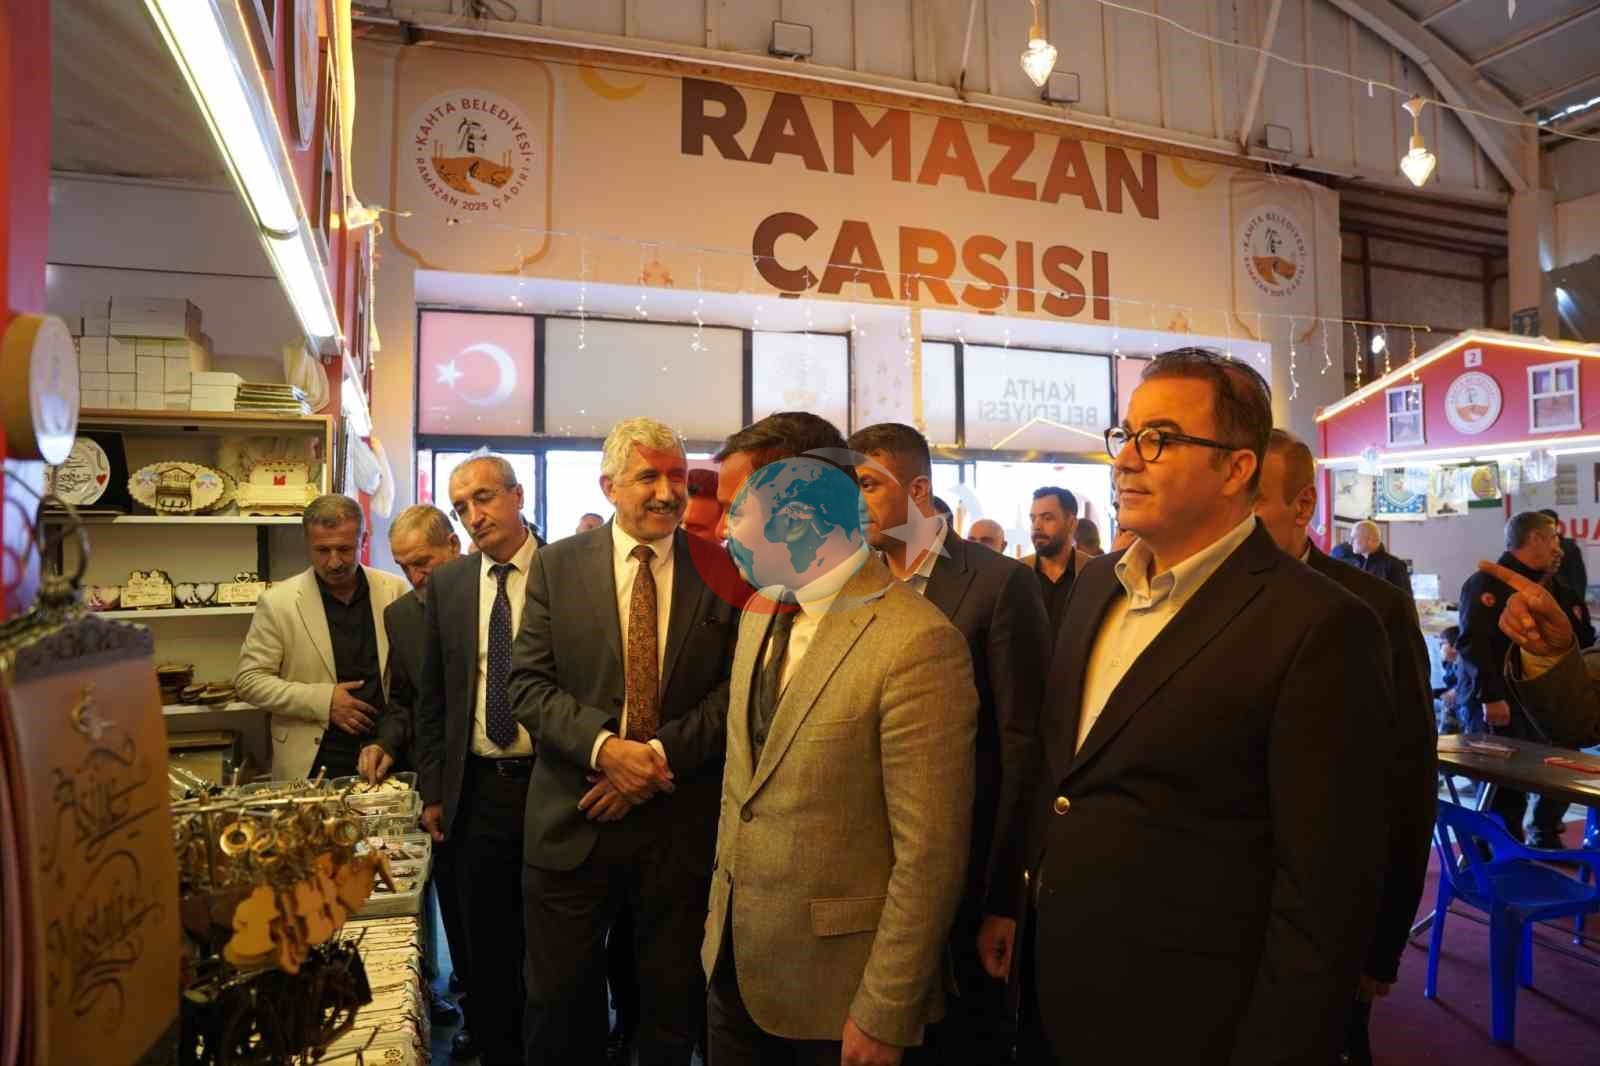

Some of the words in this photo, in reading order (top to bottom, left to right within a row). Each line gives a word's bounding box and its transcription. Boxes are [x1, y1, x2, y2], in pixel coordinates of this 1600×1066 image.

[415, 101, 456, 146] KAHTA
[461, 97, 535, 156] BELEDİYESİ
[681, 77, 1160, 220] RAMAZAN
[416, 157, 459, 206] RAMAZAN
[462, 201, 489, 211] 2025
[752, 211, 1110, 320] ÇARŞISI
